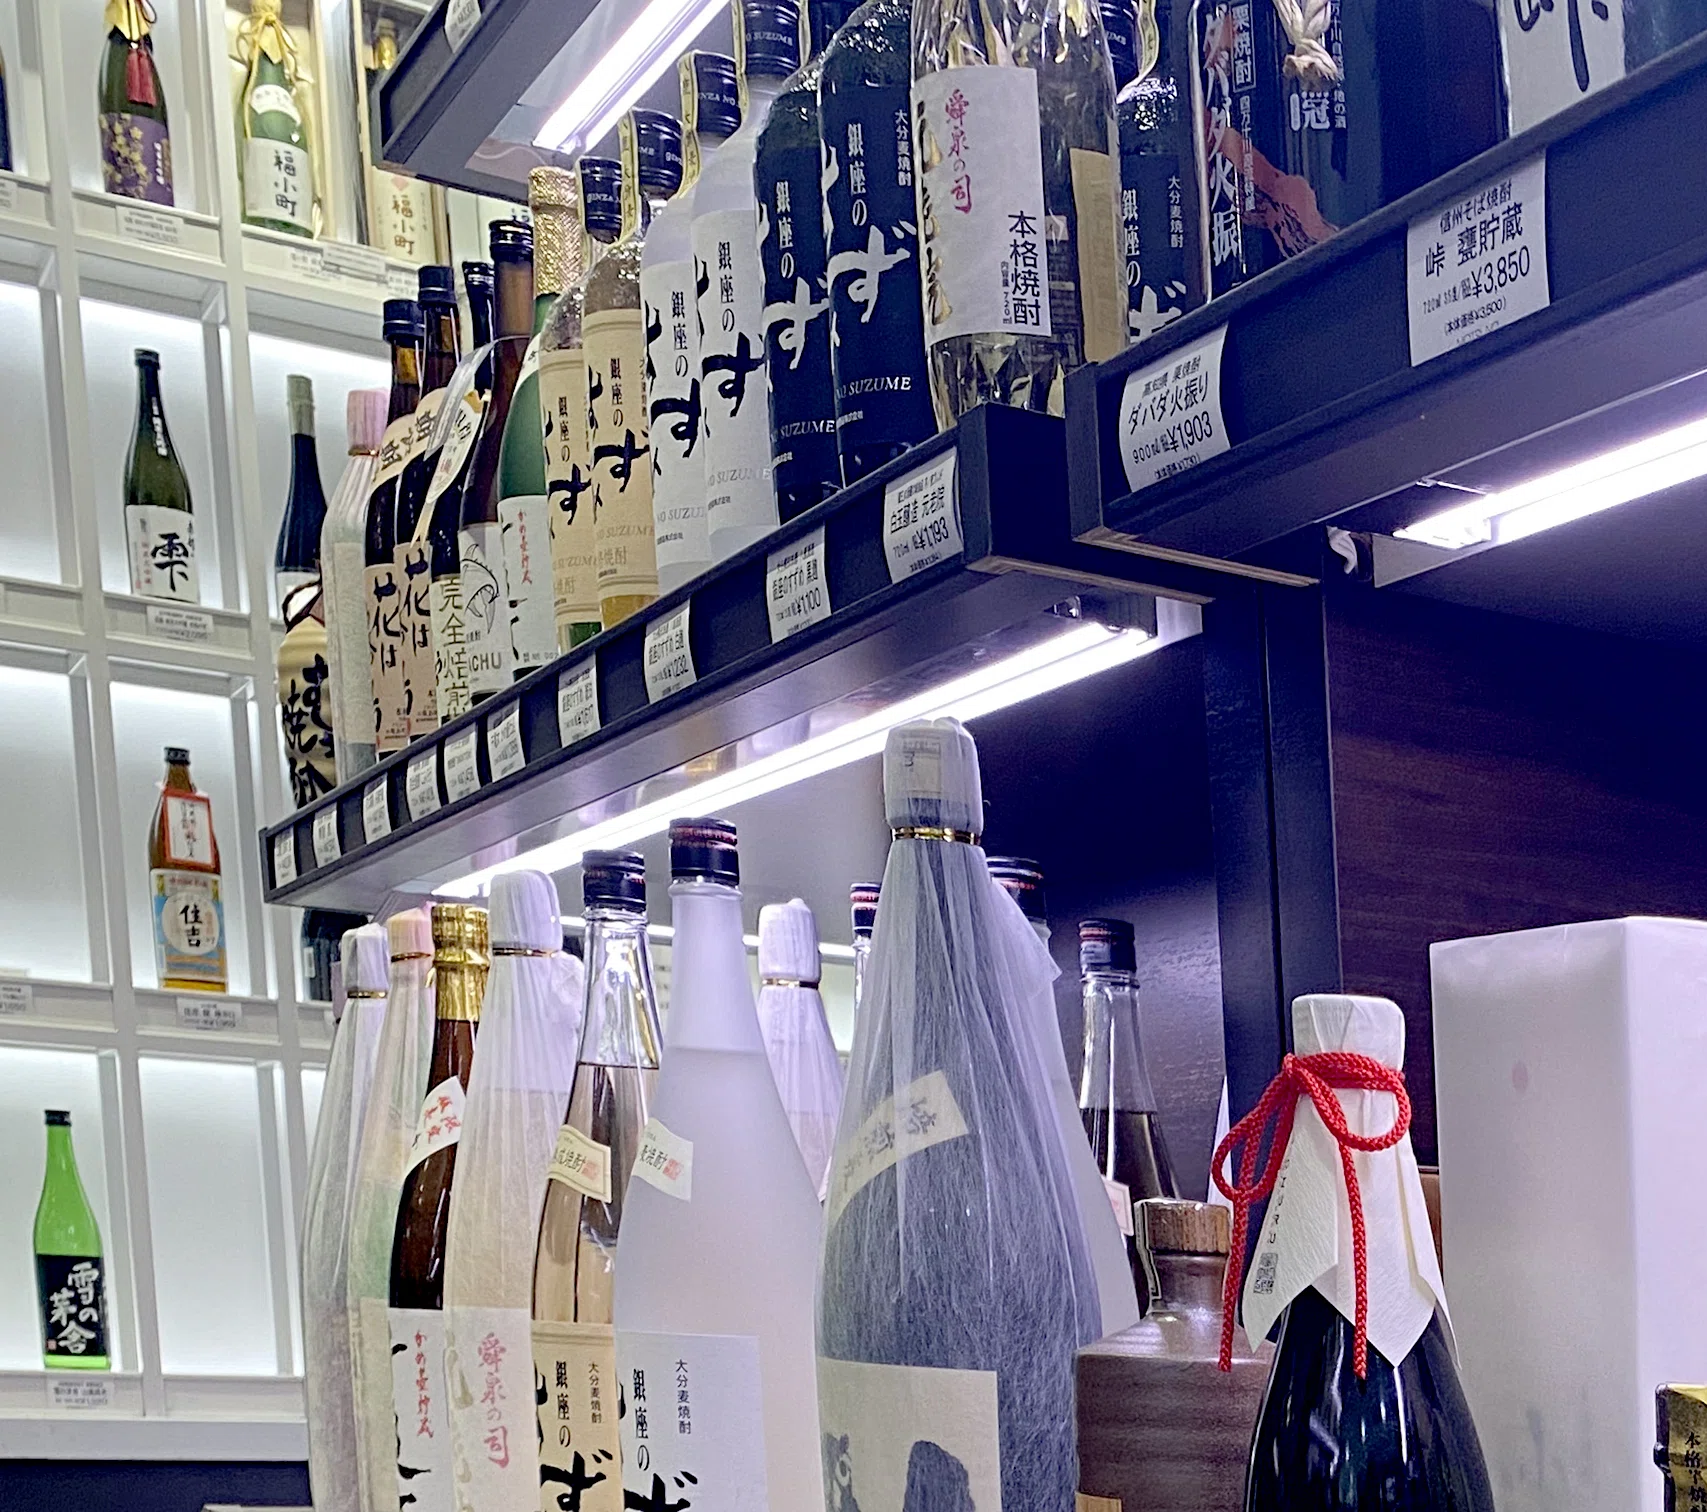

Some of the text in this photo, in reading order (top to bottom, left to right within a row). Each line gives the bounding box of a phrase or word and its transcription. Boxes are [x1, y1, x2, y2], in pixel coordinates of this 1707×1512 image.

[273, 149, 299, 218] 福小町
[847, 123, 868, 227] 銀座の
[1439, 178, 1512, 235] 信州そば焼酎
[392, 194, 415, 256] 福小町
[776, 181, 795, 280] 銀座の
[1426, 242, 1446, 278] 峠
[718, 240, 736, 332] 銀座の
[1008, 210, 1041, 326] 本格焼酎
[671, 290, 689, 377] 銀座の
[558, 396, 571, 462] 銀座の
[610, 358, 624, 428] 銀座の
[1129, 371, 1208, 435] ダバダ火振り
[177, 902, 205, 949] 住吉
[555, 1360, 571, 1448] 銀座の
[632, 1368, 650, 1472] 銀座の
[675, 1358, 692, 1435] 大分麦焼酎
